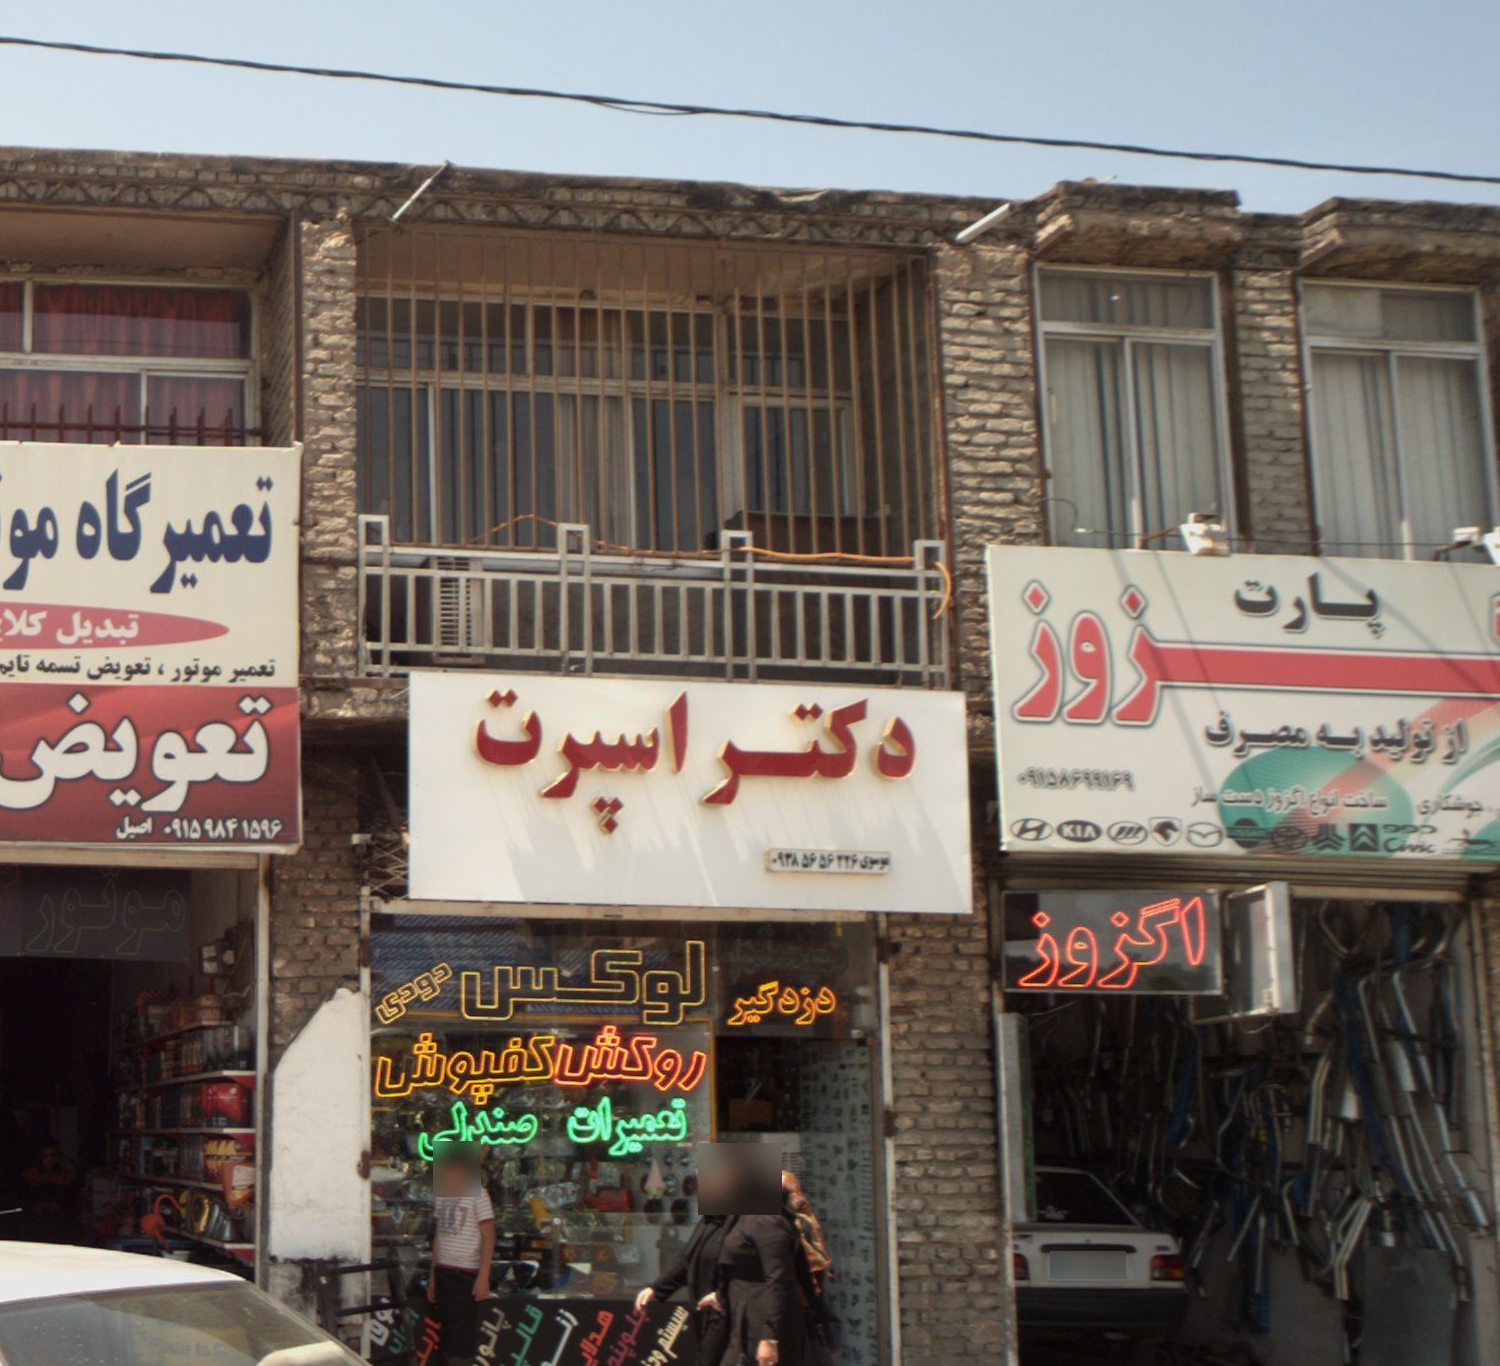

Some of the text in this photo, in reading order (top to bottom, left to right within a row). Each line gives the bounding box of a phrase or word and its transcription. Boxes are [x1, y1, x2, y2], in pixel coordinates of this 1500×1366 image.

[76, 467, 273, 595] تعمیرگاه
[55, 611, 140, 645] تبدیل
[1234, 572, 1386, 640] پارت
[36, 656, 82, 674] تسمه
[86, 656, 152, 683] تعویض
[170, 658, 222, 683] موتور
[228, 659, 276, 682] تعمیر
[1205, 710, 1468, 765] از تولید به مصرف
[473, 688, 918, 835] دکتر اسپرت
[1191, 785, 1217, 807] ساز
[1220, 787, 1264, 808] دست
[1309, 788, 1340, 817] انواع
[1343, 789, 1388, 811] ساخت
[116, 816, 153, 840] اصیل
[26, 867, 187, 955] موتور
[1018, 896, 1205, 989] اگزوز
[374, 961, 453, 1025] دودی
[460, 939, 707, 1026] لوکس
[726, 979, 837, 1026] دزدگیر
[374, 1023, 708, 1106] روکش کفپوش
[565, 1095, 689, 1158] تعمیرات
